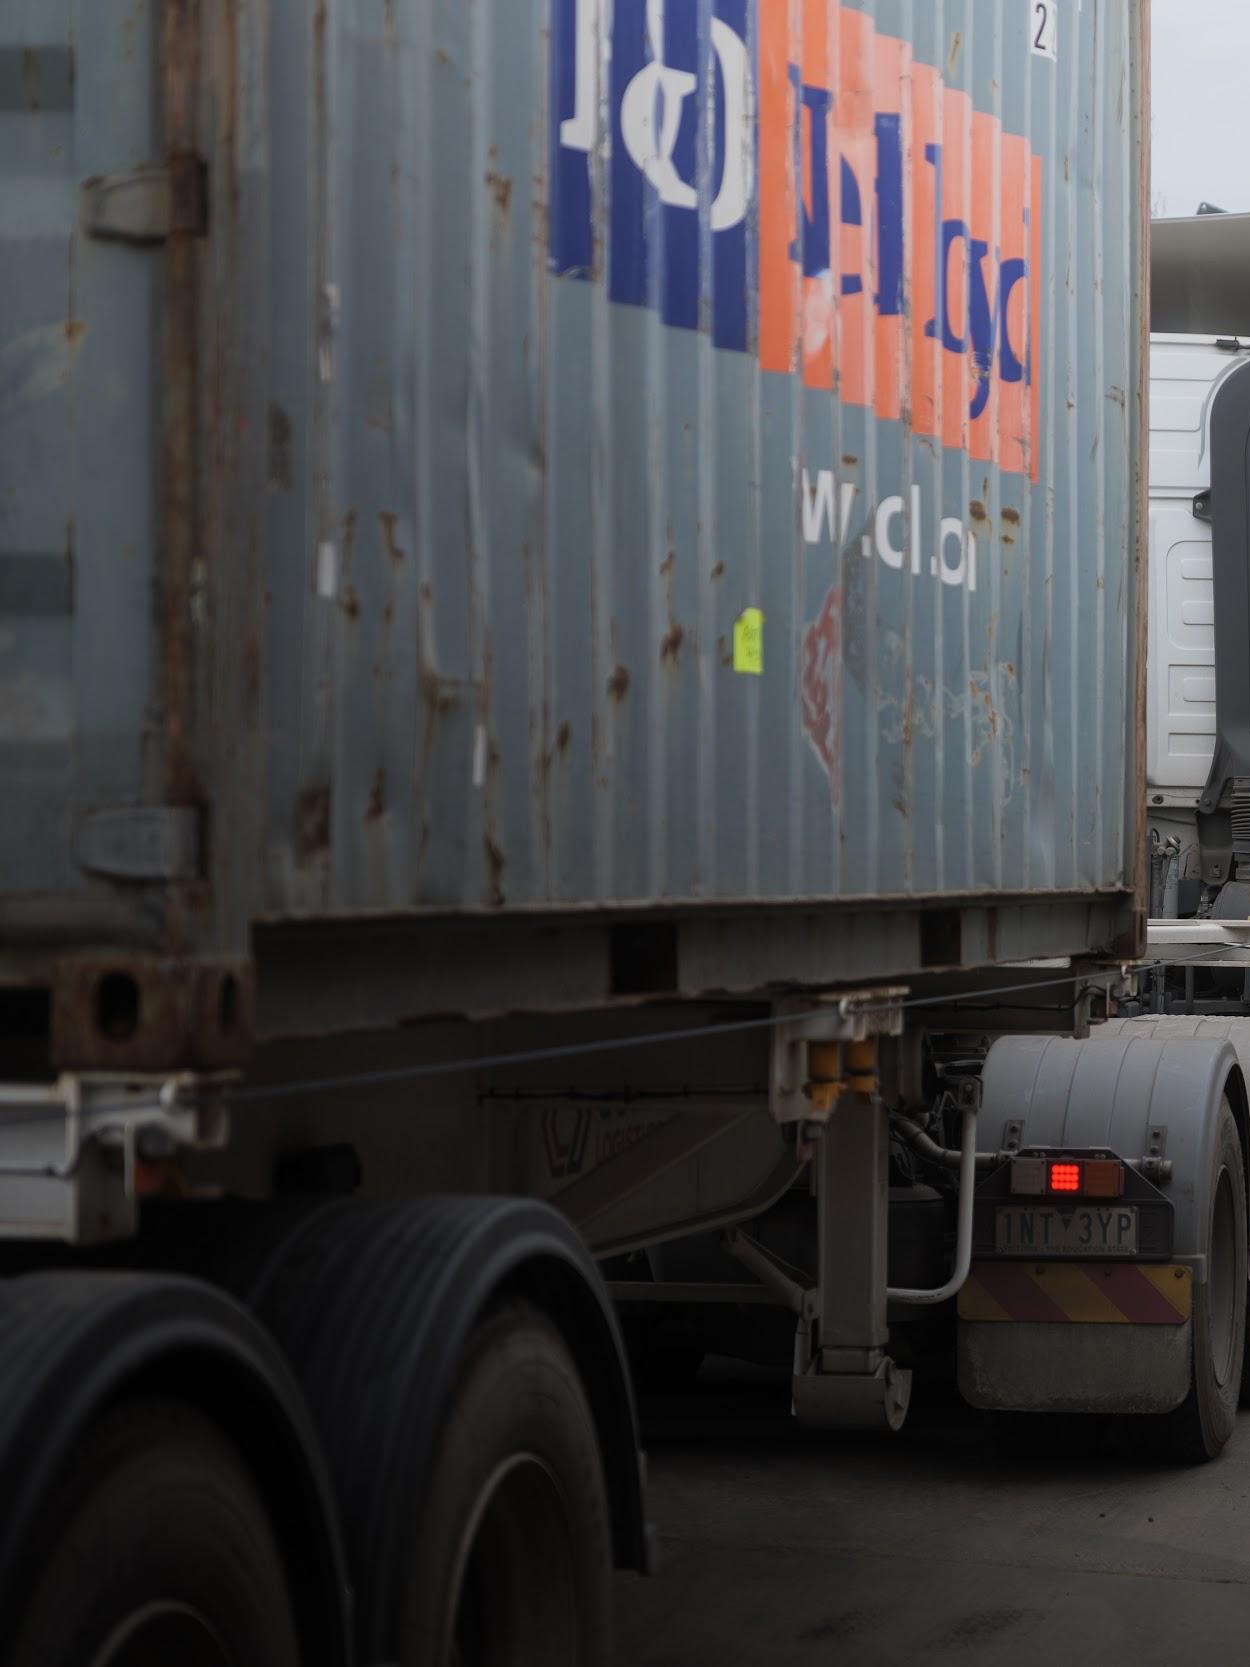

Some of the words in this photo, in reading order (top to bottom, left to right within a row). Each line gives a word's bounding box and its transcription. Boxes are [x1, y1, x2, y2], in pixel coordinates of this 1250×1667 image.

[1034, 3, 1048, 50] 2
[1003, 1212, 1053, 1245] 1NT
[1079, 1212, 1131, 1245] 3YP
